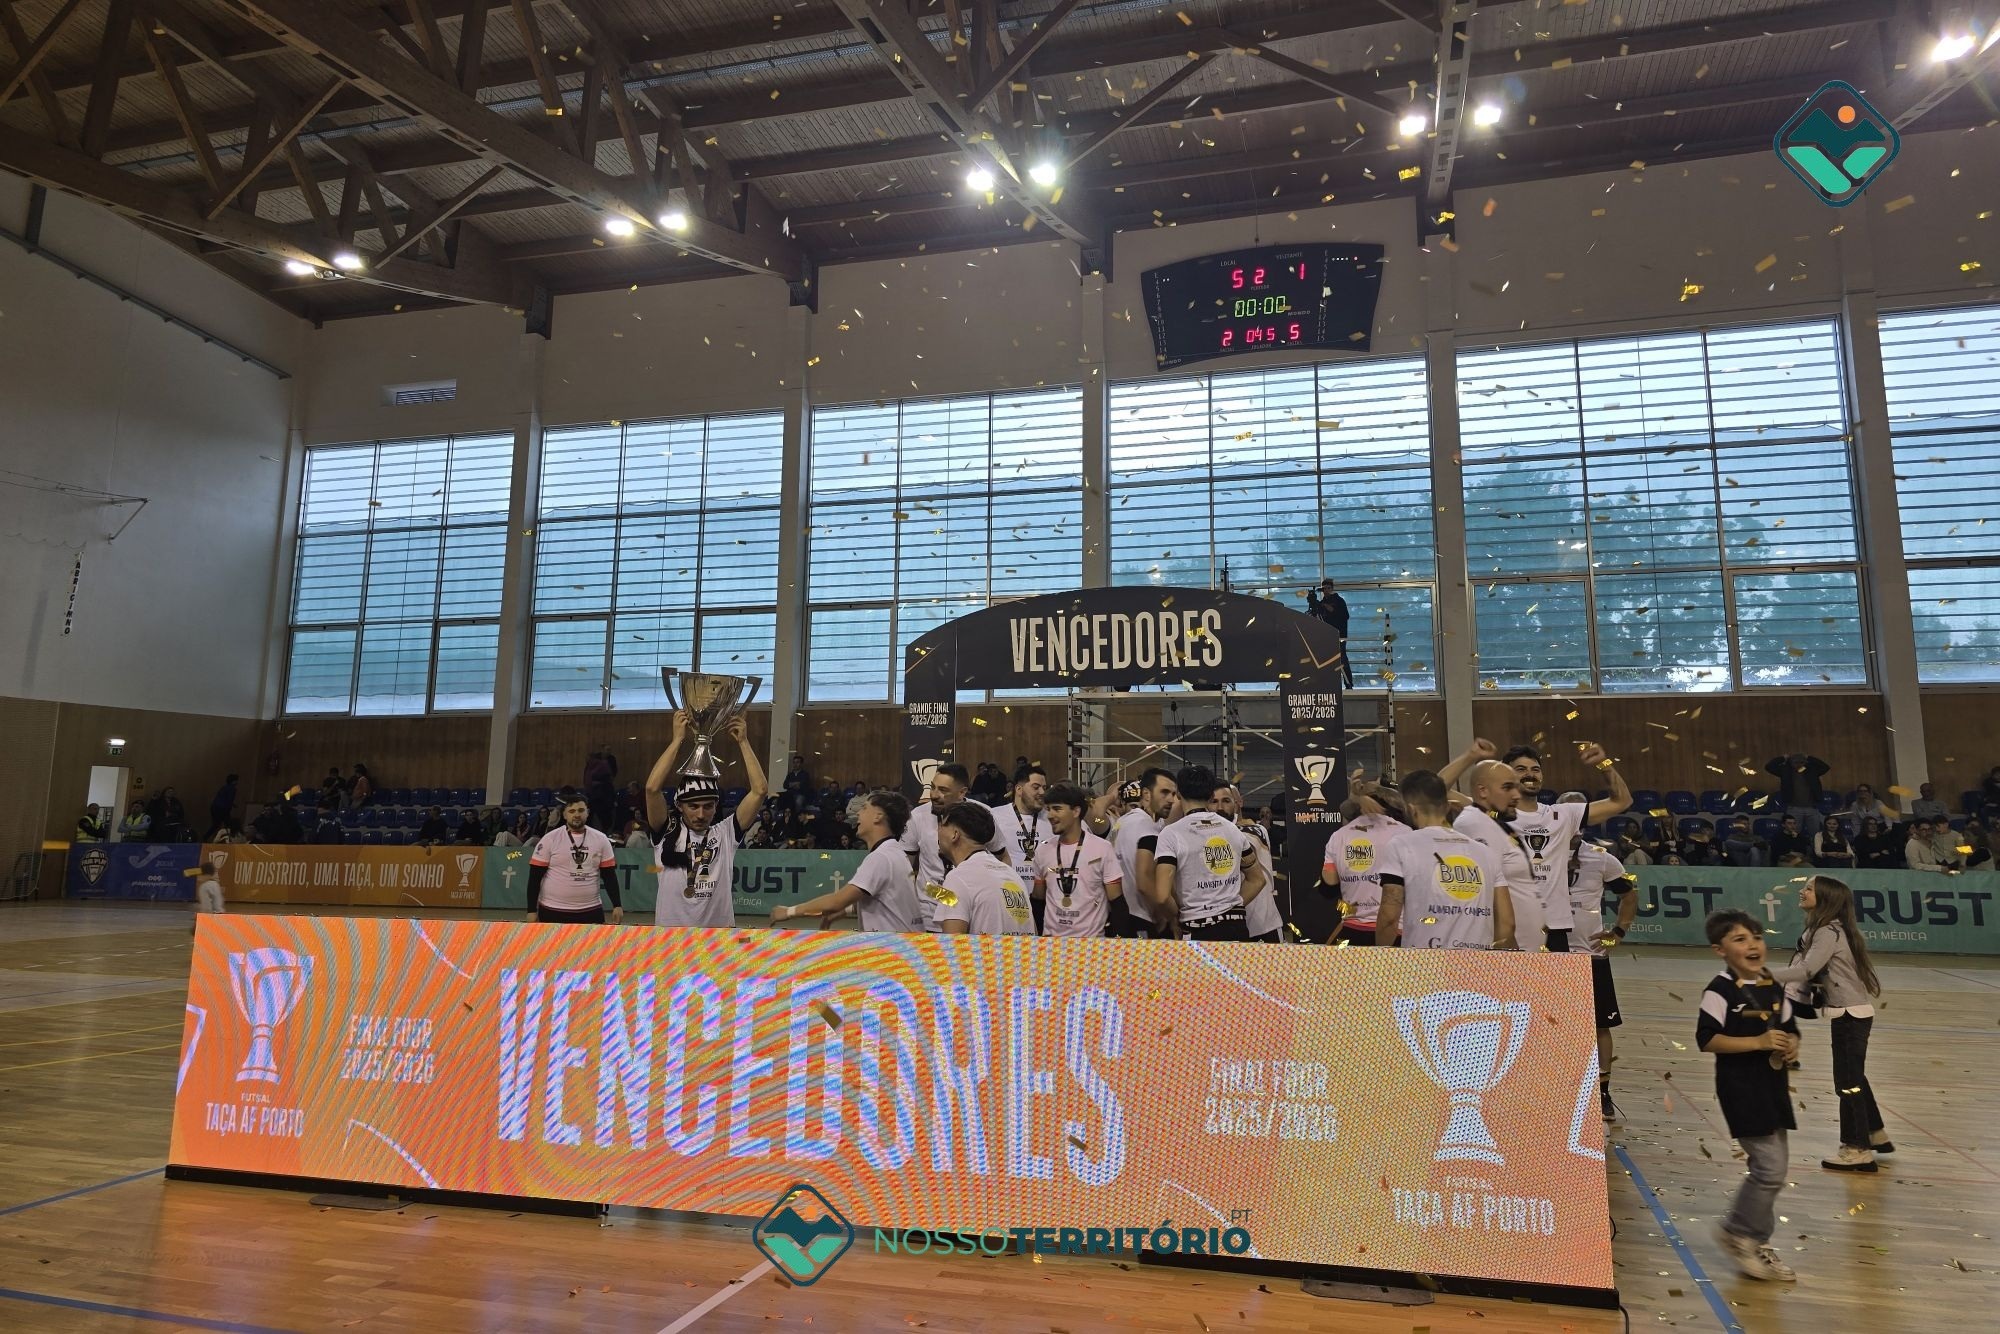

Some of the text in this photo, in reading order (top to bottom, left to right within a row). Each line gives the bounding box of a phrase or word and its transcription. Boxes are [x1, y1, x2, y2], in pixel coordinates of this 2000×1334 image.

[1220, 259, 1237, 267] LOCAL
[1232, 263, 1305, 289] 5 2 1
[1234, 296, 1286, 318] 00:00
[1222, 331, 1233, 347] 2
[1290, 324, 1300, 340] 5
[1009, 608, 1222, 674] VENCEDORES
[908, 701, 950, 714] GRANDE FINAL
[1287, 693, 1338, 706] GRANDE FINAL
[910, 713, 948, 726] 2025/2026
[1291, 705, 1336, 719] 2025/2026
[1294, 811, 1341, 824] TAÇA AF PORTO
[1345, 844, 1375, 861] BOM
[233, 861, 445, 891] UM DISTRITO, UMA TAÇA, UM SONHO
[731, 865, 807, 894] UST
[1197, 879, 1223, 889] ALIMENTA
[1439, 862, 1483, 885] BOM
[1428, 904, 1461, 915] ALIMENTA
[1853, 889, 1993, 927] RUST
[1627, 921, 1663, 933] ÉDICA
[1880, 929, 1928, 941] MÉDICA
[348, 1014, 389, 1047] FINAL
[340, 1048, 435, 1084] 2025/2026
[497, 968, 1125, 1186] VENCEDORES
[1210, 1057, 1266, 1096] FINAL
[240, 1092, 271, 1104] FUTSAL
[205, 1101, 305, 1138] TAÇA AF PORTO
[1204, 1096, 1338, 1143] 2025/2026
[1392, 1186, 1556, 1236] TAÇA AF PORTO
